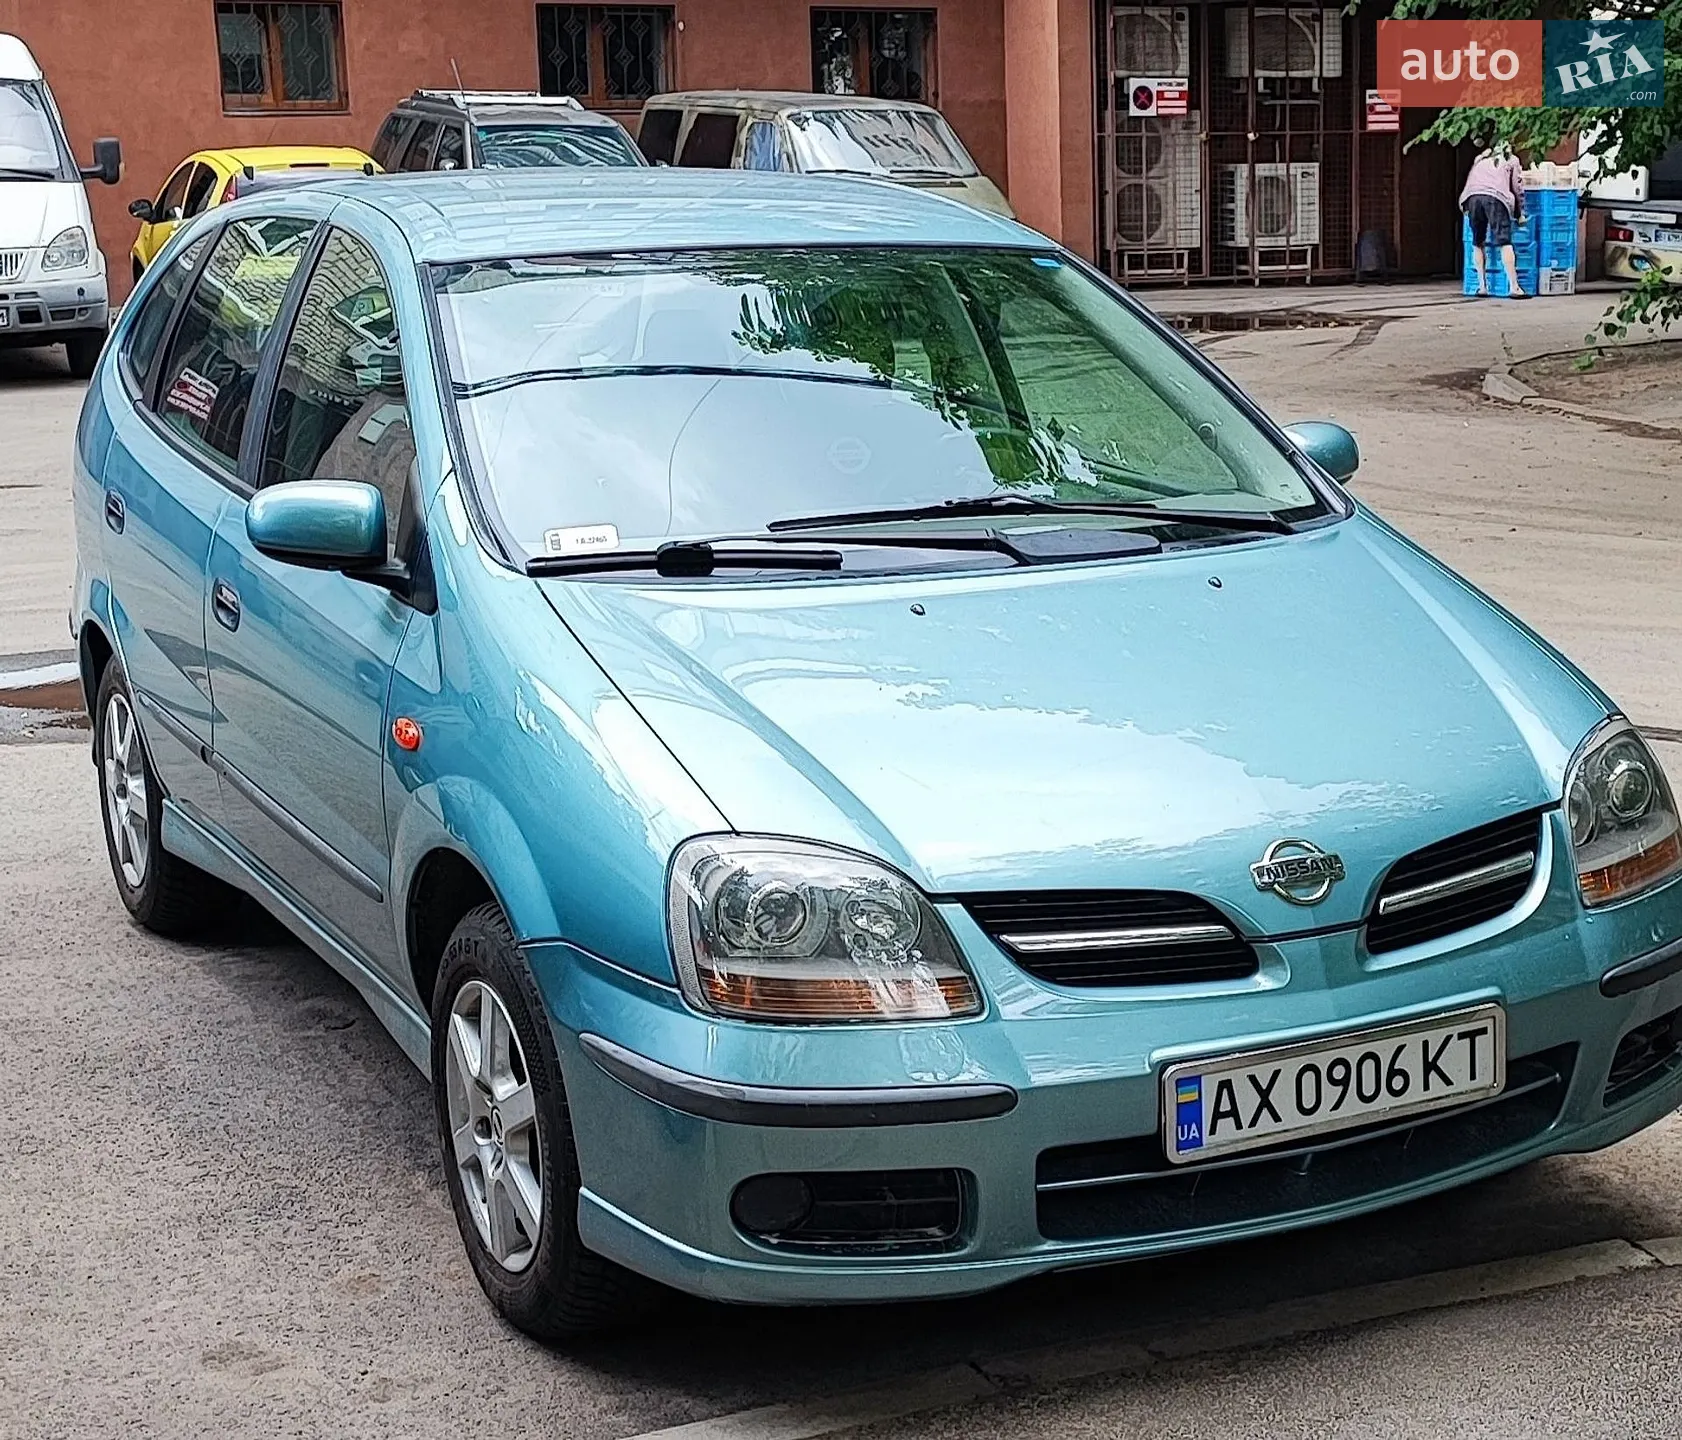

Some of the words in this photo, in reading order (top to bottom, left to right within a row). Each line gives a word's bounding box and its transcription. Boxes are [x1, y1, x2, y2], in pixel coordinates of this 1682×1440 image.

[1264, 857, 1335, 880] NISSAN
[1208, 1068, 1283, 1136] AX
[1295, 1043, 1411, 1117] 0906
[1422, 1026, 1489, 1093] KT
[1177, 1123, 1200, 1142] UA
